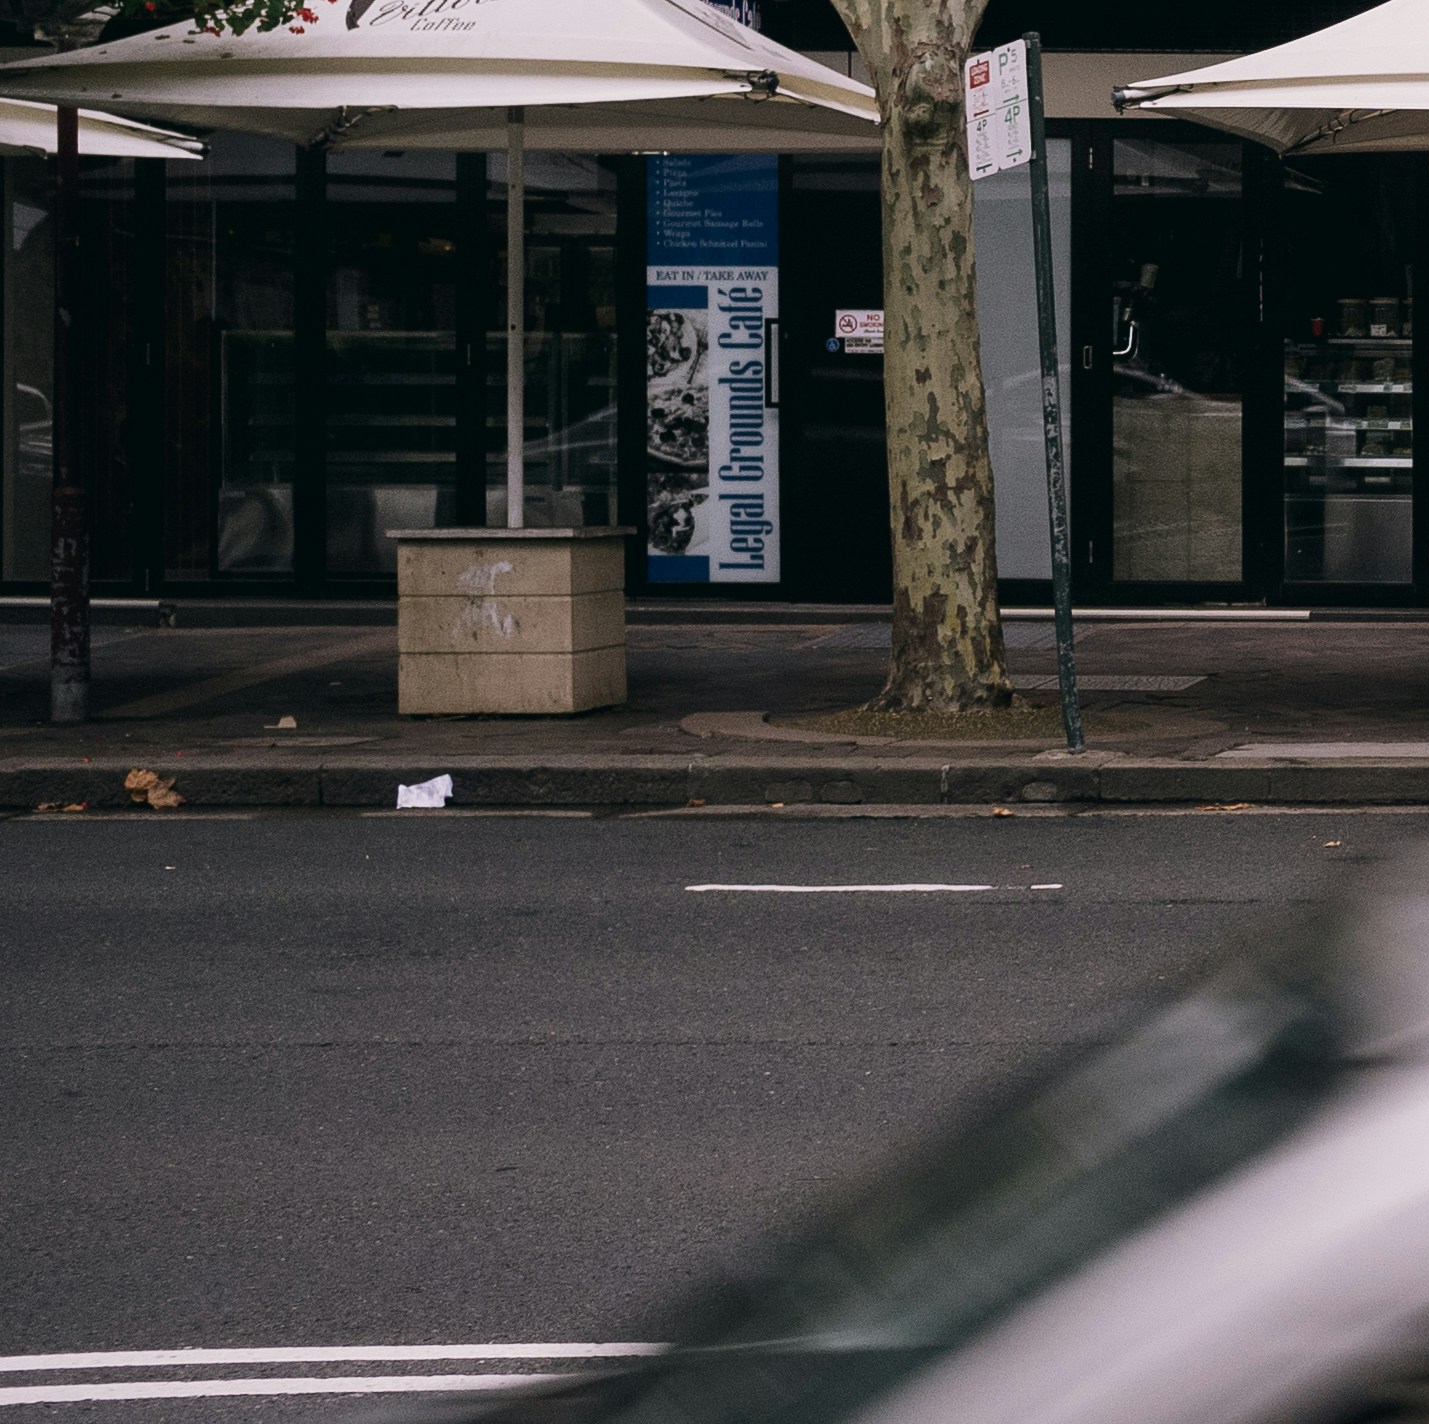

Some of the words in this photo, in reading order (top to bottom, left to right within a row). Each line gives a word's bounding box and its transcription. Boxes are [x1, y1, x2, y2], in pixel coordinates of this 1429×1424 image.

[410, 17, 477, 32] Coffee
[1004, 105, 1021, 124] 4P
[656, 270, 678, 281] EAT
[682, 270, 695, 281] IN
[704, 270, 735, 281] TAKE
[737, 270, 769, 281] AWAY
[716, 286, 764, 350] Café
[866, 313, 881, 322] NO
[717, 359, 765, 483] Grounds
[717, 492, 774, 571] Legal
